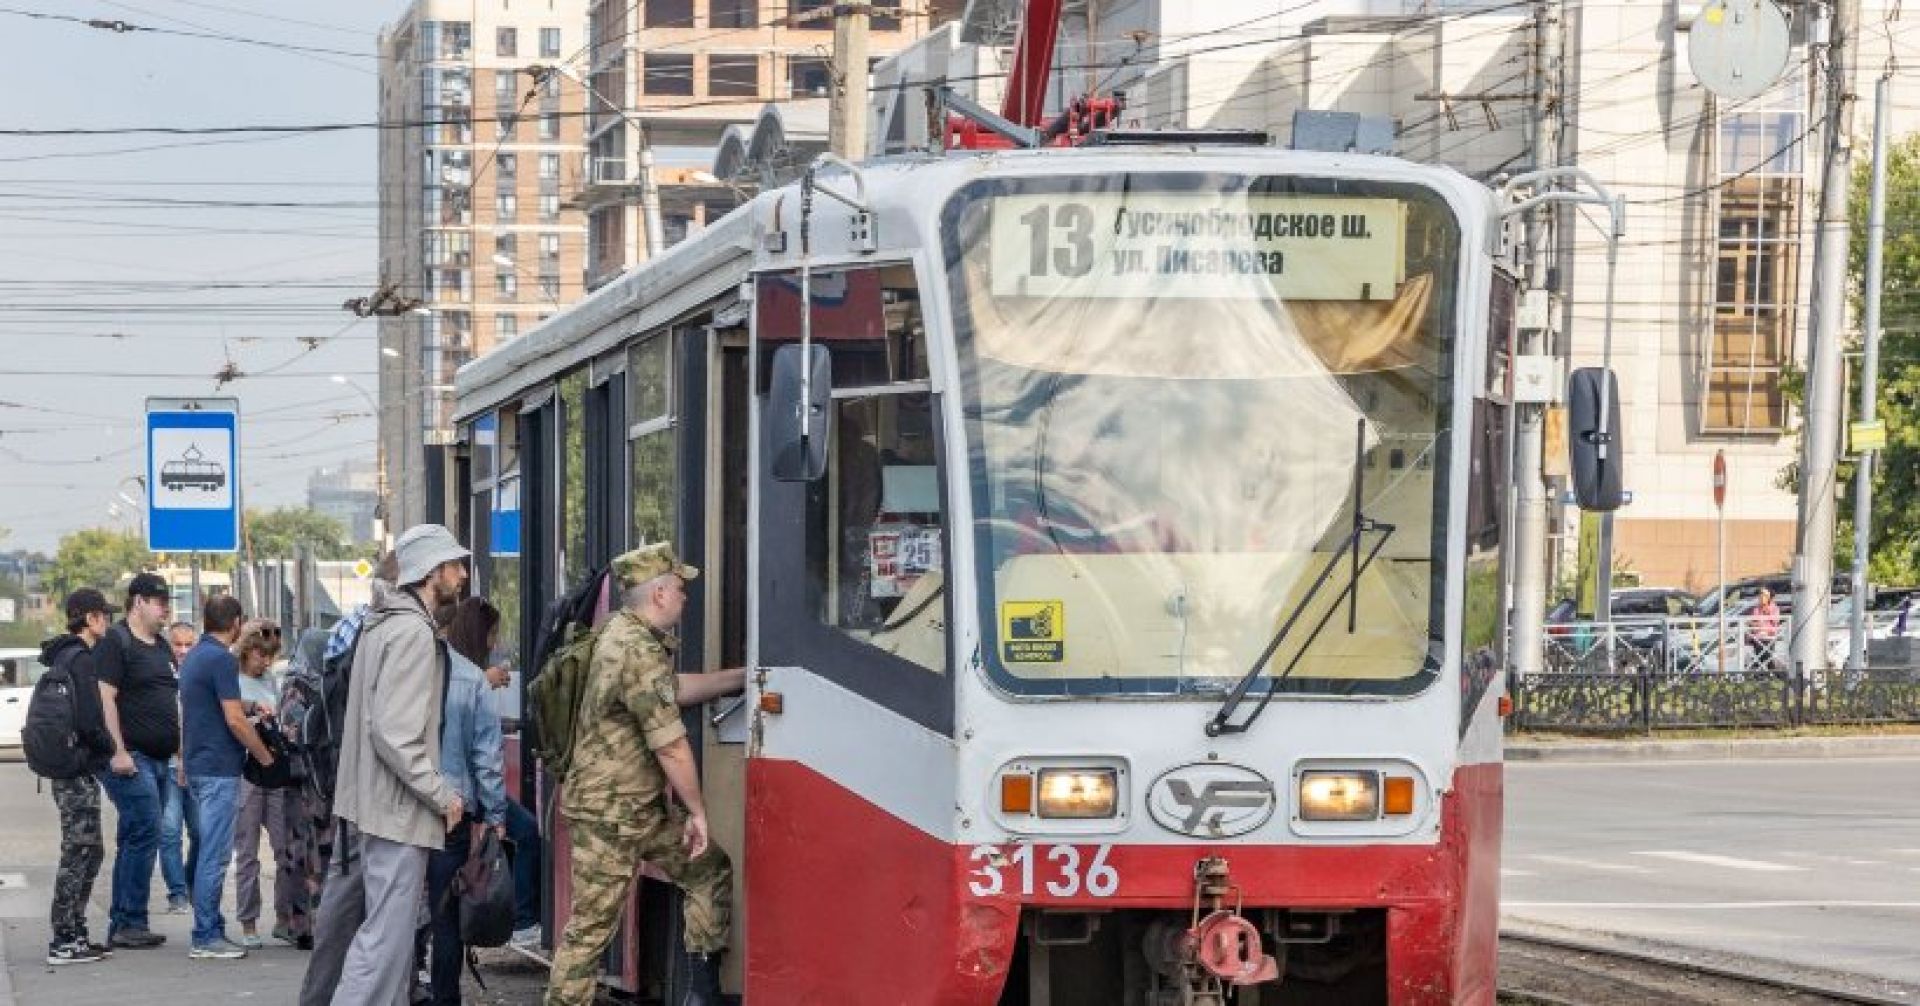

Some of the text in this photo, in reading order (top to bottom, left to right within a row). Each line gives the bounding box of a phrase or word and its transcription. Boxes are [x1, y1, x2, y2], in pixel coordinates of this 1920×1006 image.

[1020, 203, 1094, 278] 13
[1341, 213, 1372, 238] ш.
[1113, 246, 1284, 276] ул. Писарева
[968, 843, 1120, 897] 3136
